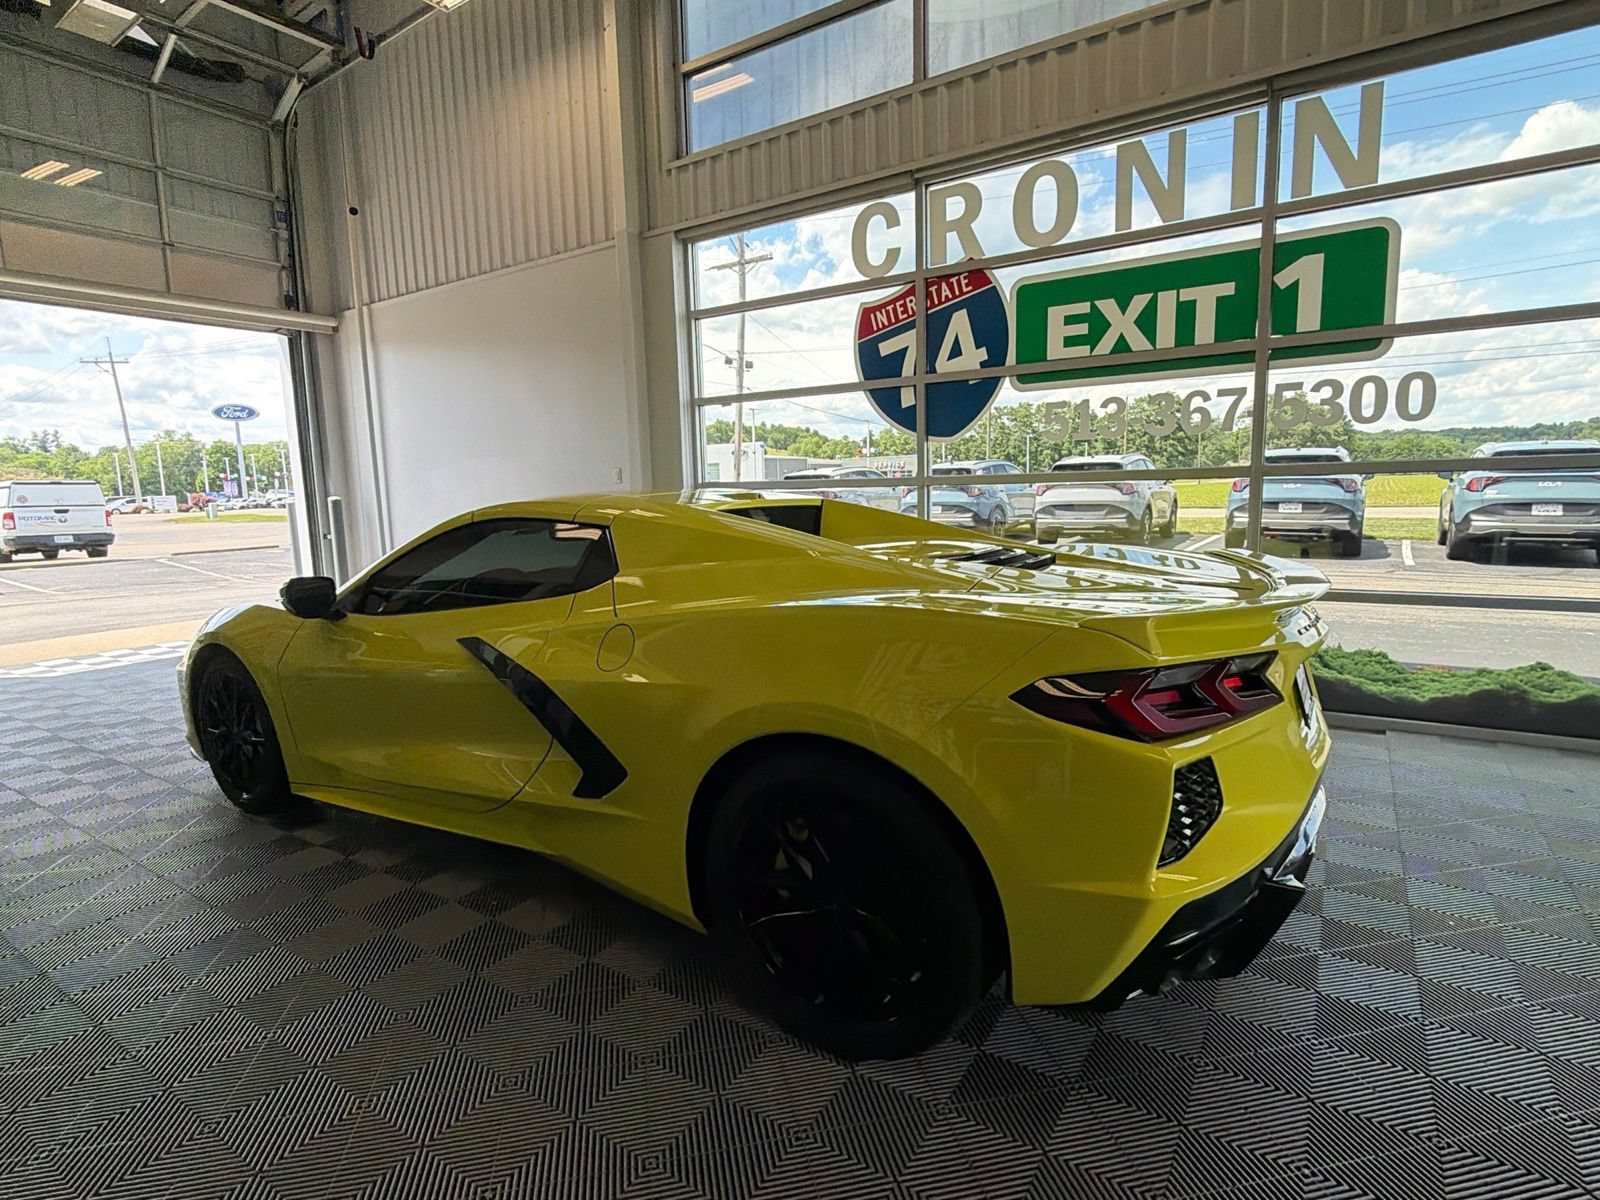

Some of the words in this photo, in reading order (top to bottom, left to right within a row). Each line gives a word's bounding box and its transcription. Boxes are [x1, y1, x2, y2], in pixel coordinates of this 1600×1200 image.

[850, 80, 1385, 280] CRONIN
[869, 272, 973, 332] INTERTATE
[1046, 281, 1237, 361] EXIT
[1272, 253, 1325, 333] 1
[877, 307, 989, 409] 74
[220, 406, 249, 418] Ford
